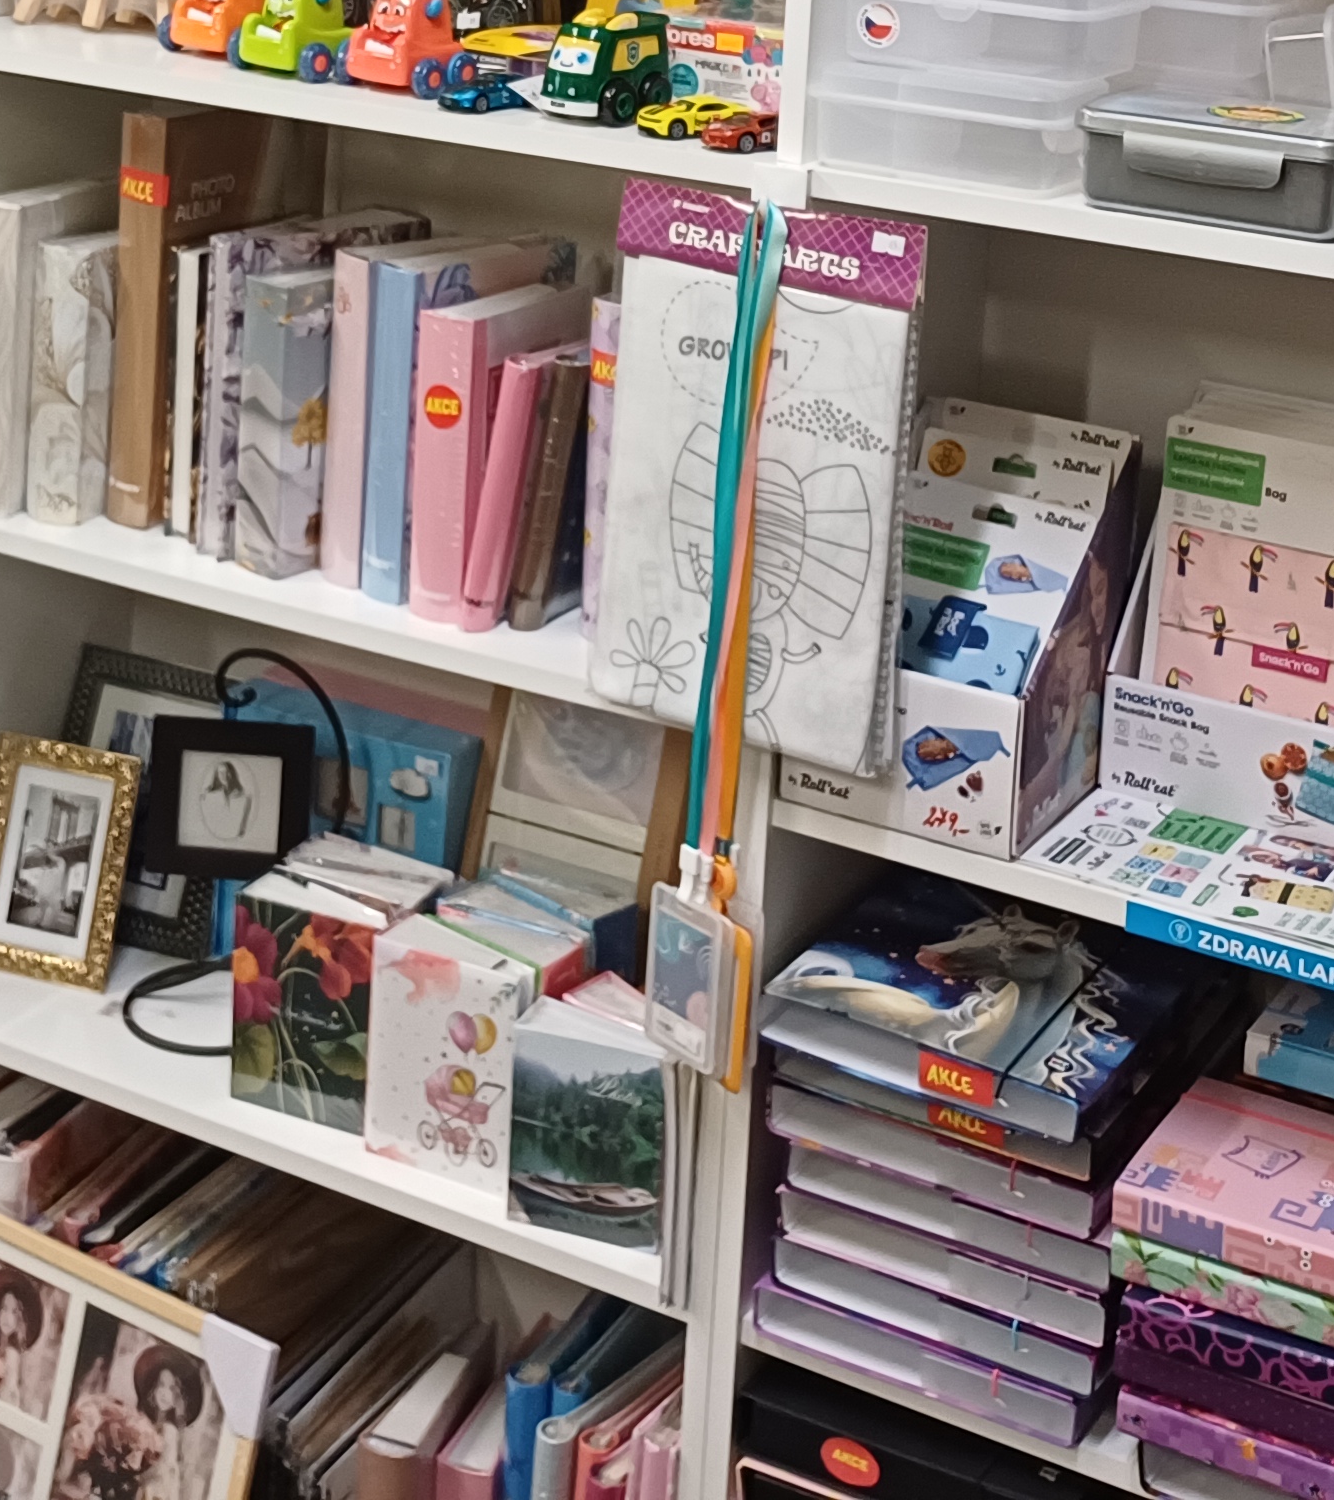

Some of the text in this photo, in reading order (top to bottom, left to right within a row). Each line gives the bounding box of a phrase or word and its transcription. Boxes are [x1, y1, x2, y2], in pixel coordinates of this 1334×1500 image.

[668, 30, 715, 49] ores
[121, 177, 154, 203] AKCE
[190, 174, 235, 199] PHOTO
[668, 220, 746, 257] CRAF
[427, 397, 459, 415] AKCE
[1114, 685, 1195, 719] Snack'n'Go
[1190, 720, 1210, 736] Bag
[1197, 929, 1293, 974] ZDRAVÁ
[927, 1064, 974, 1096] AKCE
